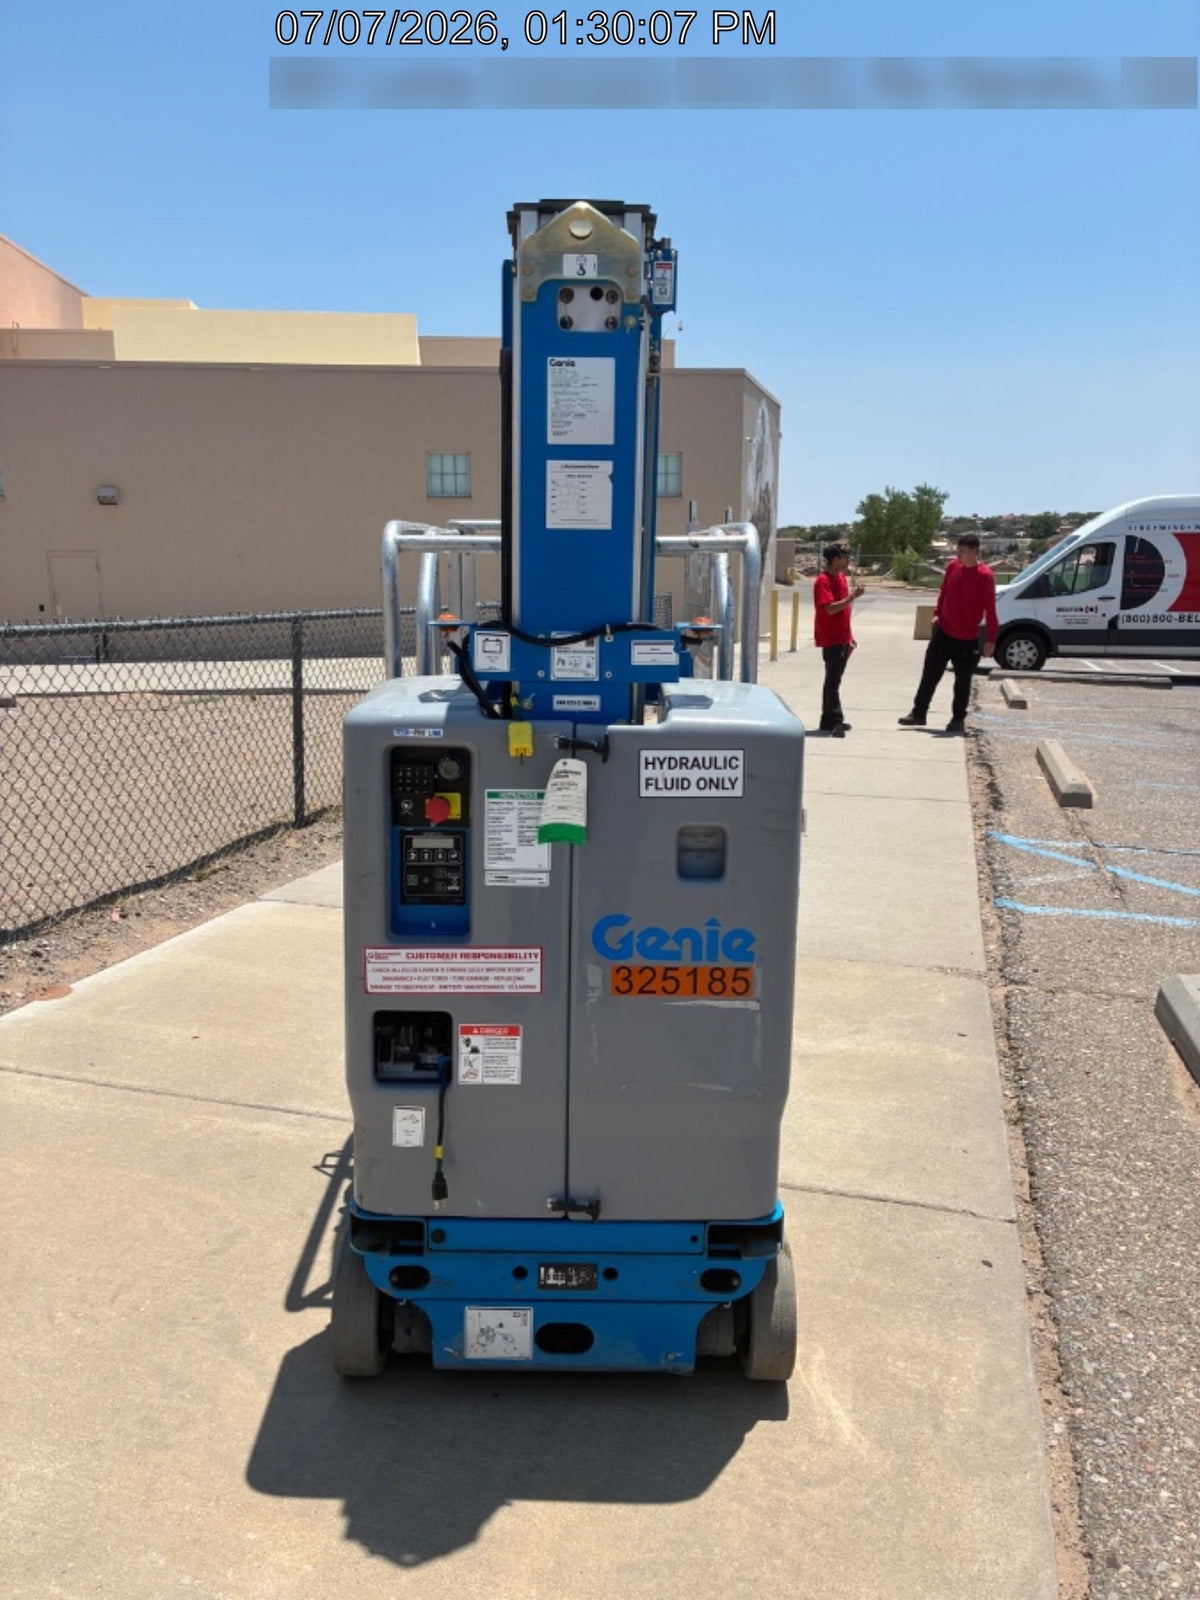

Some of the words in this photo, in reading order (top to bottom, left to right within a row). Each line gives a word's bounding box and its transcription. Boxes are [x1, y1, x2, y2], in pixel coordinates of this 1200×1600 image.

[644, 756, 740, 771] HYDRAULIC
[644, 776, 691, 791] FLUID
[696, 776, 739, 791] ONLY
[591, 913, 757, 962] Genie
[405, 952, 458, 961] CUSTOMER
[460, 952, 539, 960] RESPONSIBILITY
[614, 966, 751, 996] 325185
